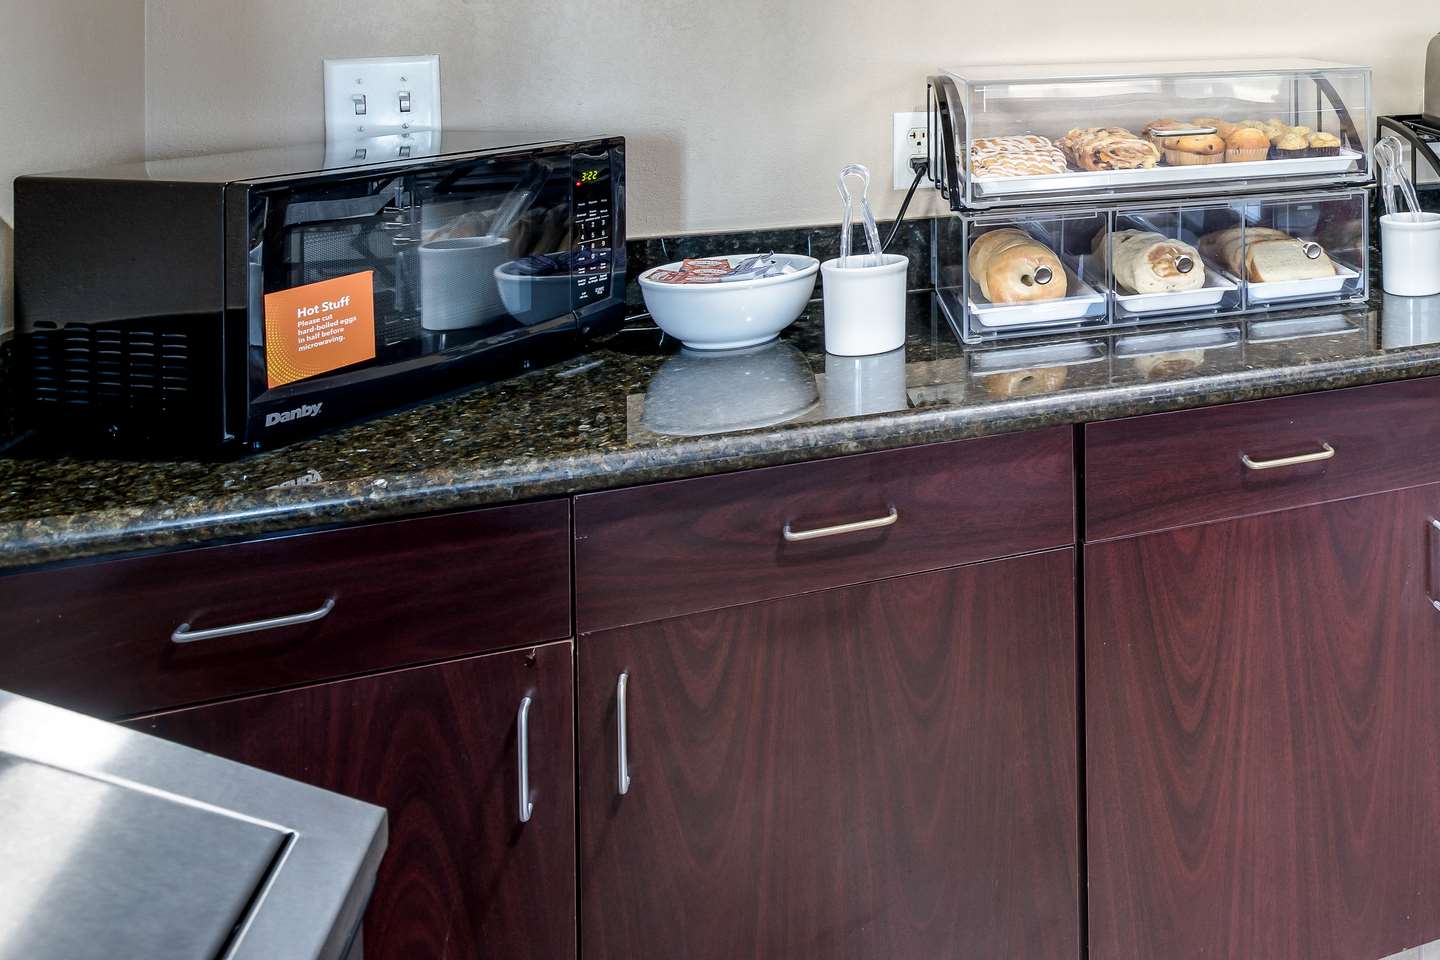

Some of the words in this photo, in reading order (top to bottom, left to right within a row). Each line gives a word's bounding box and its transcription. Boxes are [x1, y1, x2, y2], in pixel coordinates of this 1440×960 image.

[581, 170, 598, 182] 3:22
[297, 305, 320, 318] Hot
[321, 296, 350, 312] Stuff
[297, 317, 321, 328] Please
[321, 314, 333, 322] cut
[297, 320, 339, 336] hard-boiled
[340, 315, 357, 326] eggs
[306, 332, 321, 342] half
[321, 327, 345, 337] before
[265, 402, 323, 427] Danby
